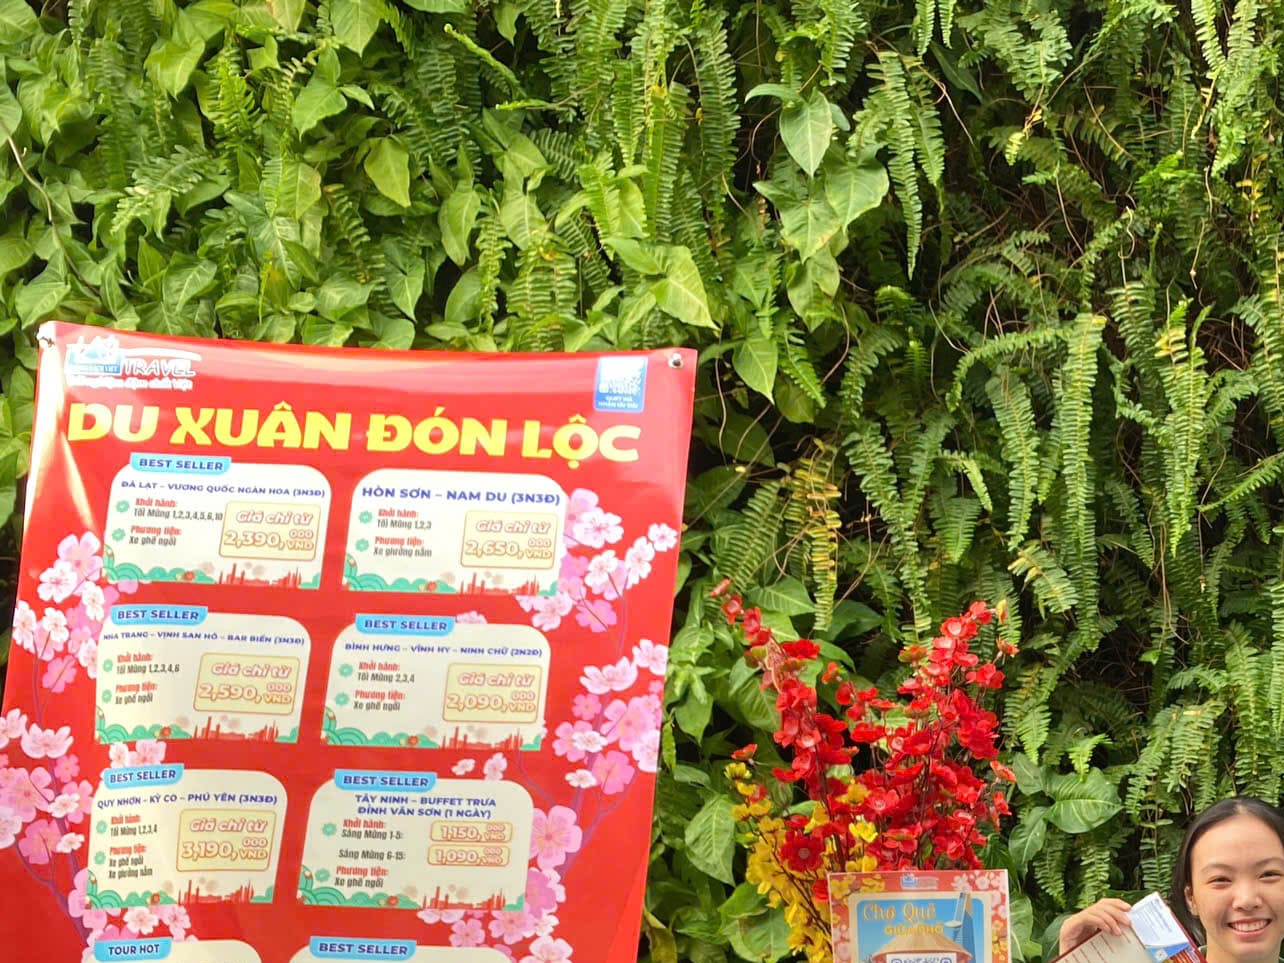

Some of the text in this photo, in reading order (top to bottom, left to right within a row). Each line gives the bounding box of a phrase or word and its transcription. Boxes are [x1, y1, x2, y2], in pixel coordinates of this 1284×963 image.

[68, 400, 641, 470] DU XUÂN ĐÓN LỘC
[139, 458, 223, 470] BEST SELLER
[362, 488, 560, 506] HÒN SƠN NAM DU (3N3Đ)
[108, 944, 160, 955] TOUR HOT
[319, 943, 408, 954] BEST SELLER
